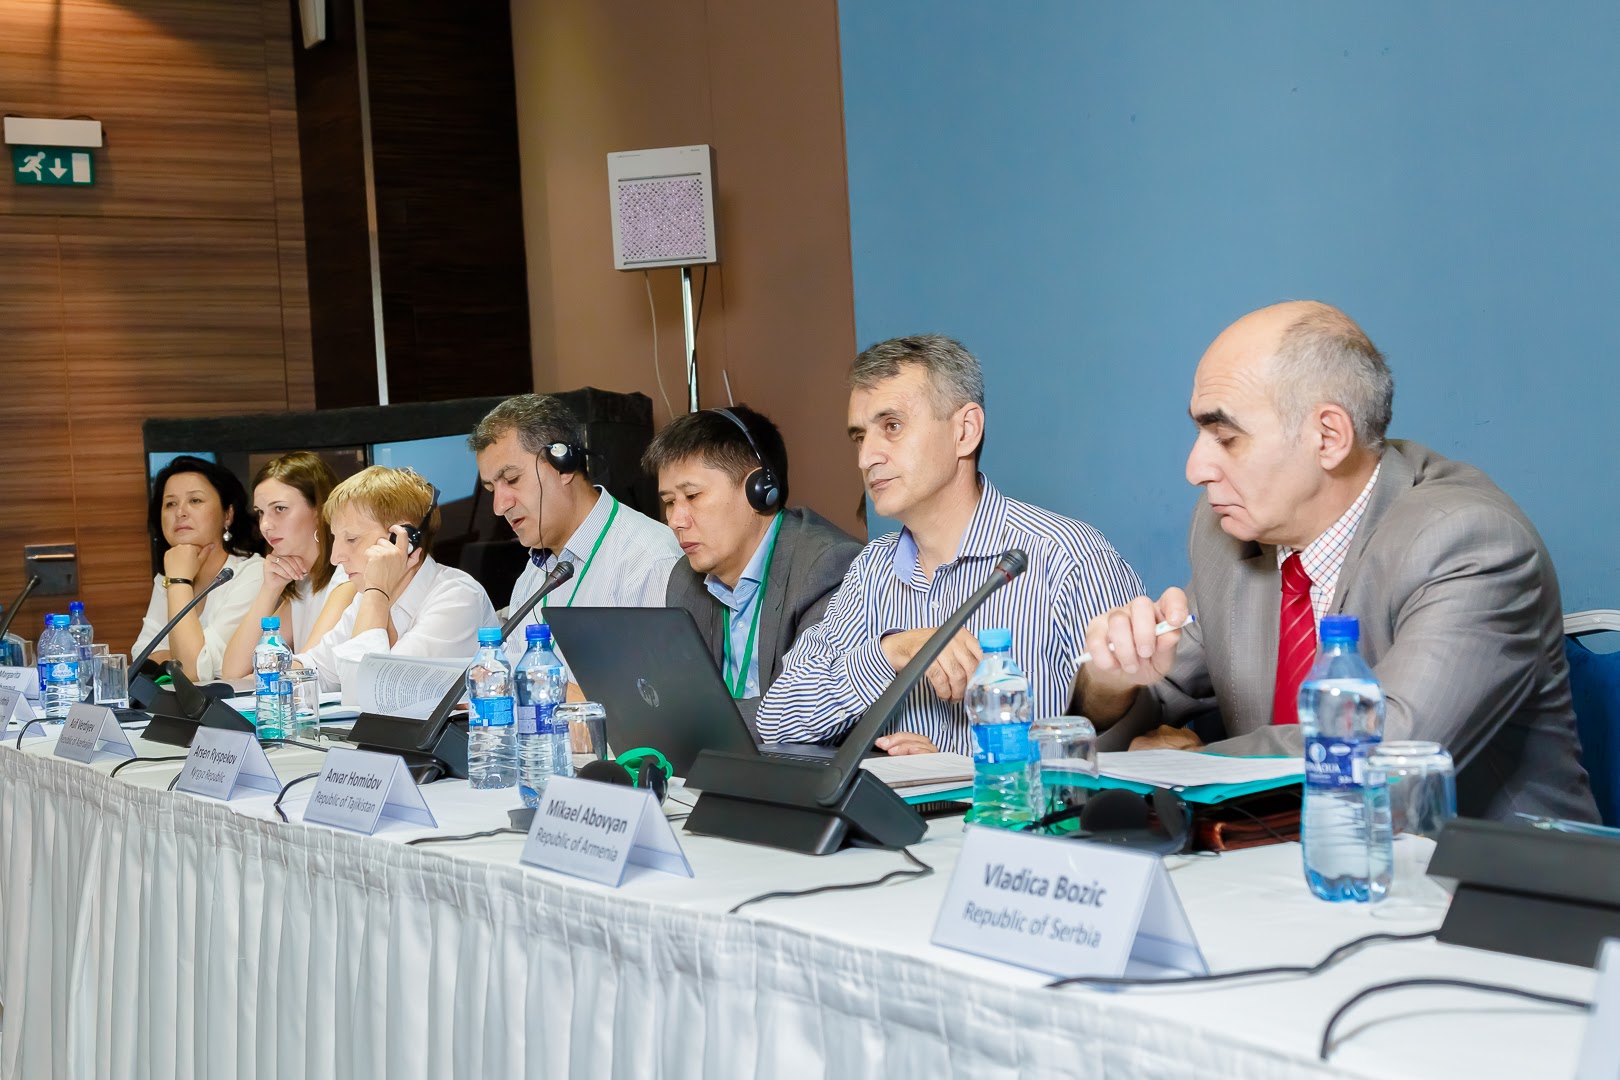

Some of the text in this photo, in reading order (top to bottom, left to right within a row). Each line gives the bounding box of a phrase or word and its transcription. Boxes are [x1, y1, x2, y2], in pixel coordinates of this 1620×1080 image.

[193, 744, 238, 765] Arsen Ryspekov
[205, 769, 226, 784] Republic
[325, 768, 382, 790] Anvar Homidov
[315, 791, 376, 813] Republic of Tajikistan
[545, 799, 628, 835] Mikael Abovyan
[535, 827, 619, 862] Republic of Armenia
[984, 862, 1107, 908] Vladica Bozic
[963, 901, 1102, 949] Republic of Serbia
